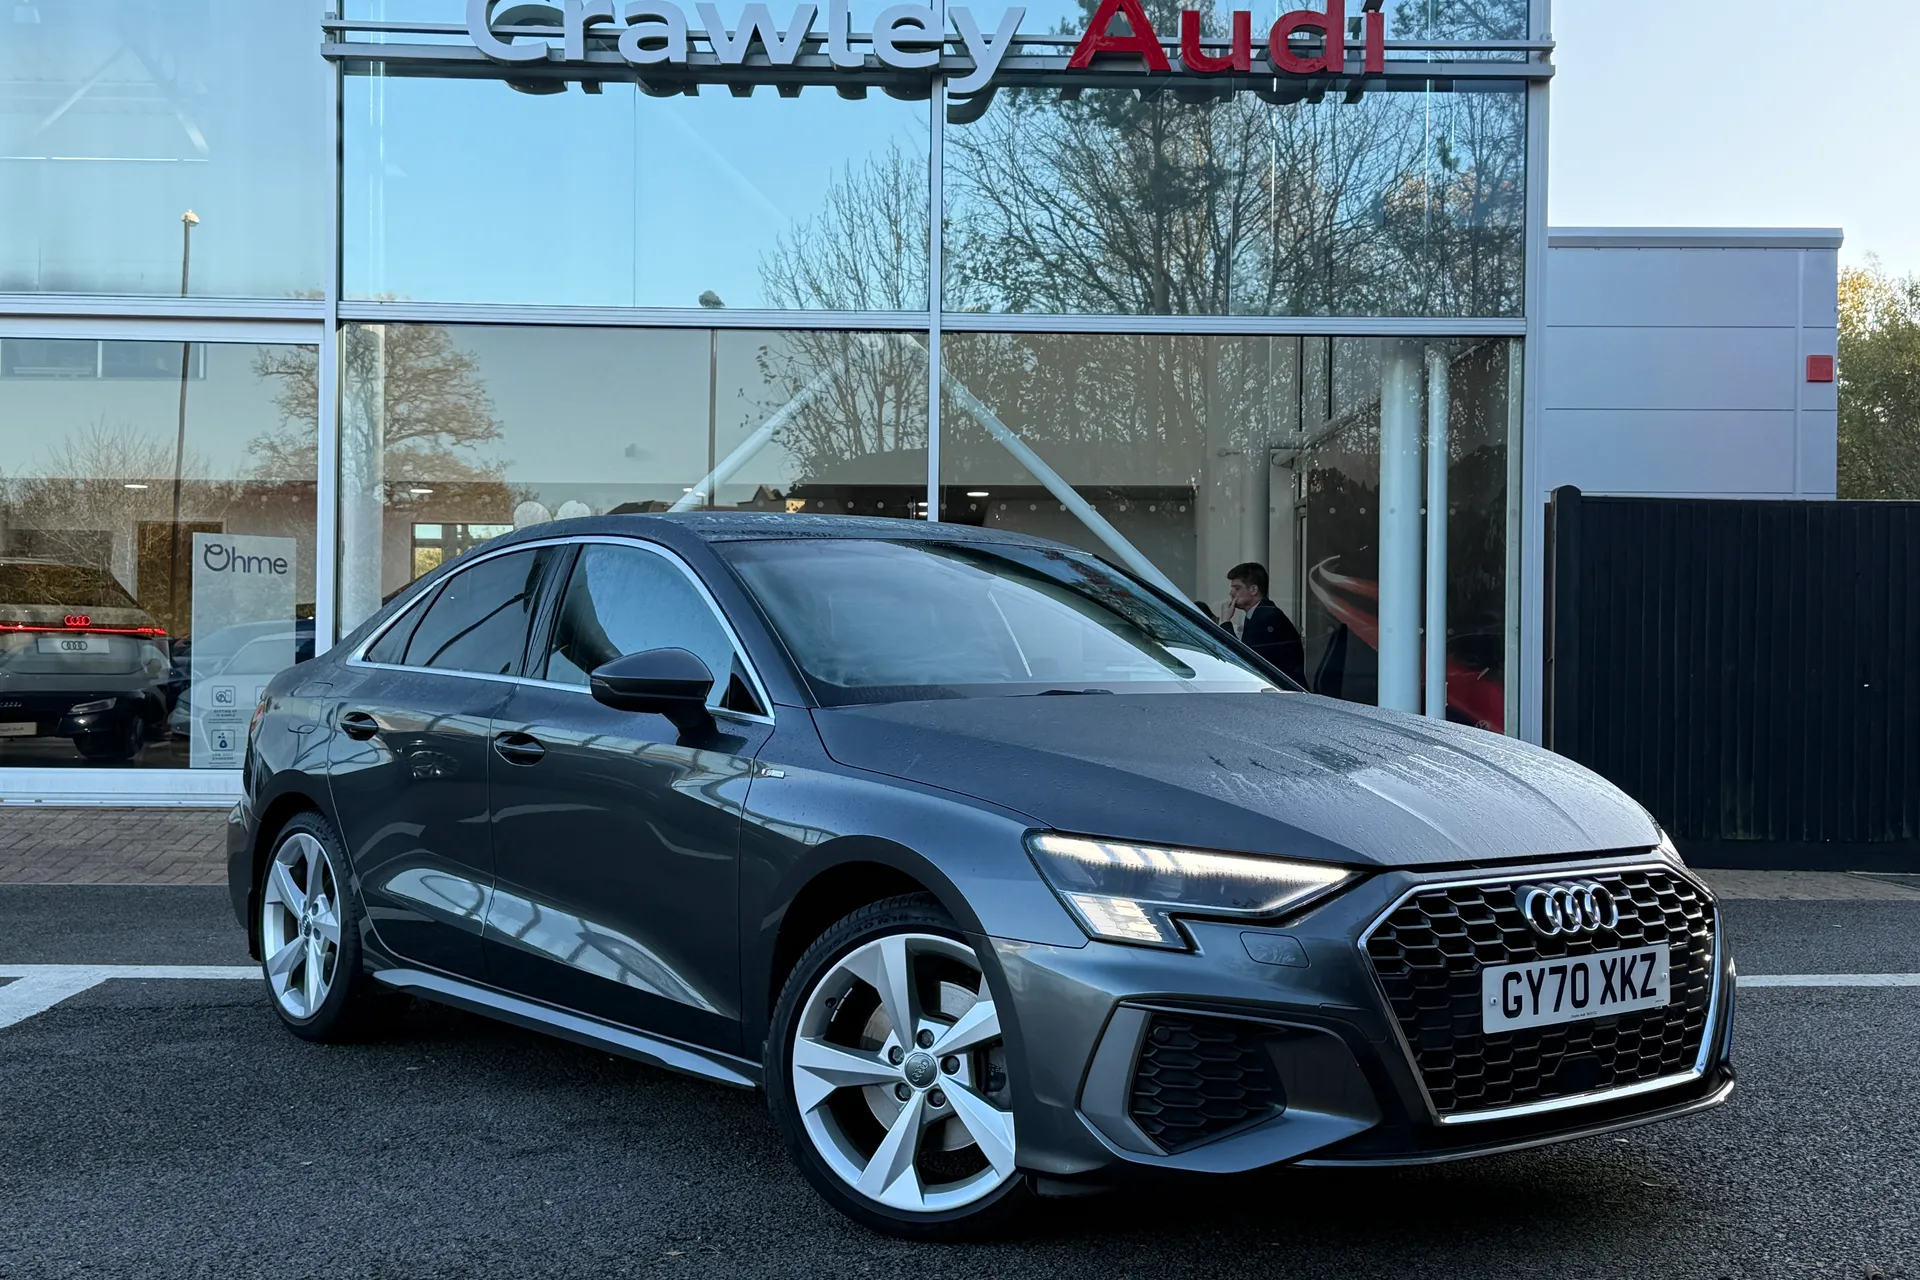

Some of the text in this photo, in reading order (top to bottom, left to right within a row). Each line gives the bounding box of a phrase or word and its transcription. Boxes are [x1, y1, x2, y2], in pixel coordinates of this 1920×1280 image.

[466, 0, 1385, 99] Crawley Audi
[203, 543, 288, 575] Ohme
[1502, 951, 1657, 1019] GY70 XKZ
